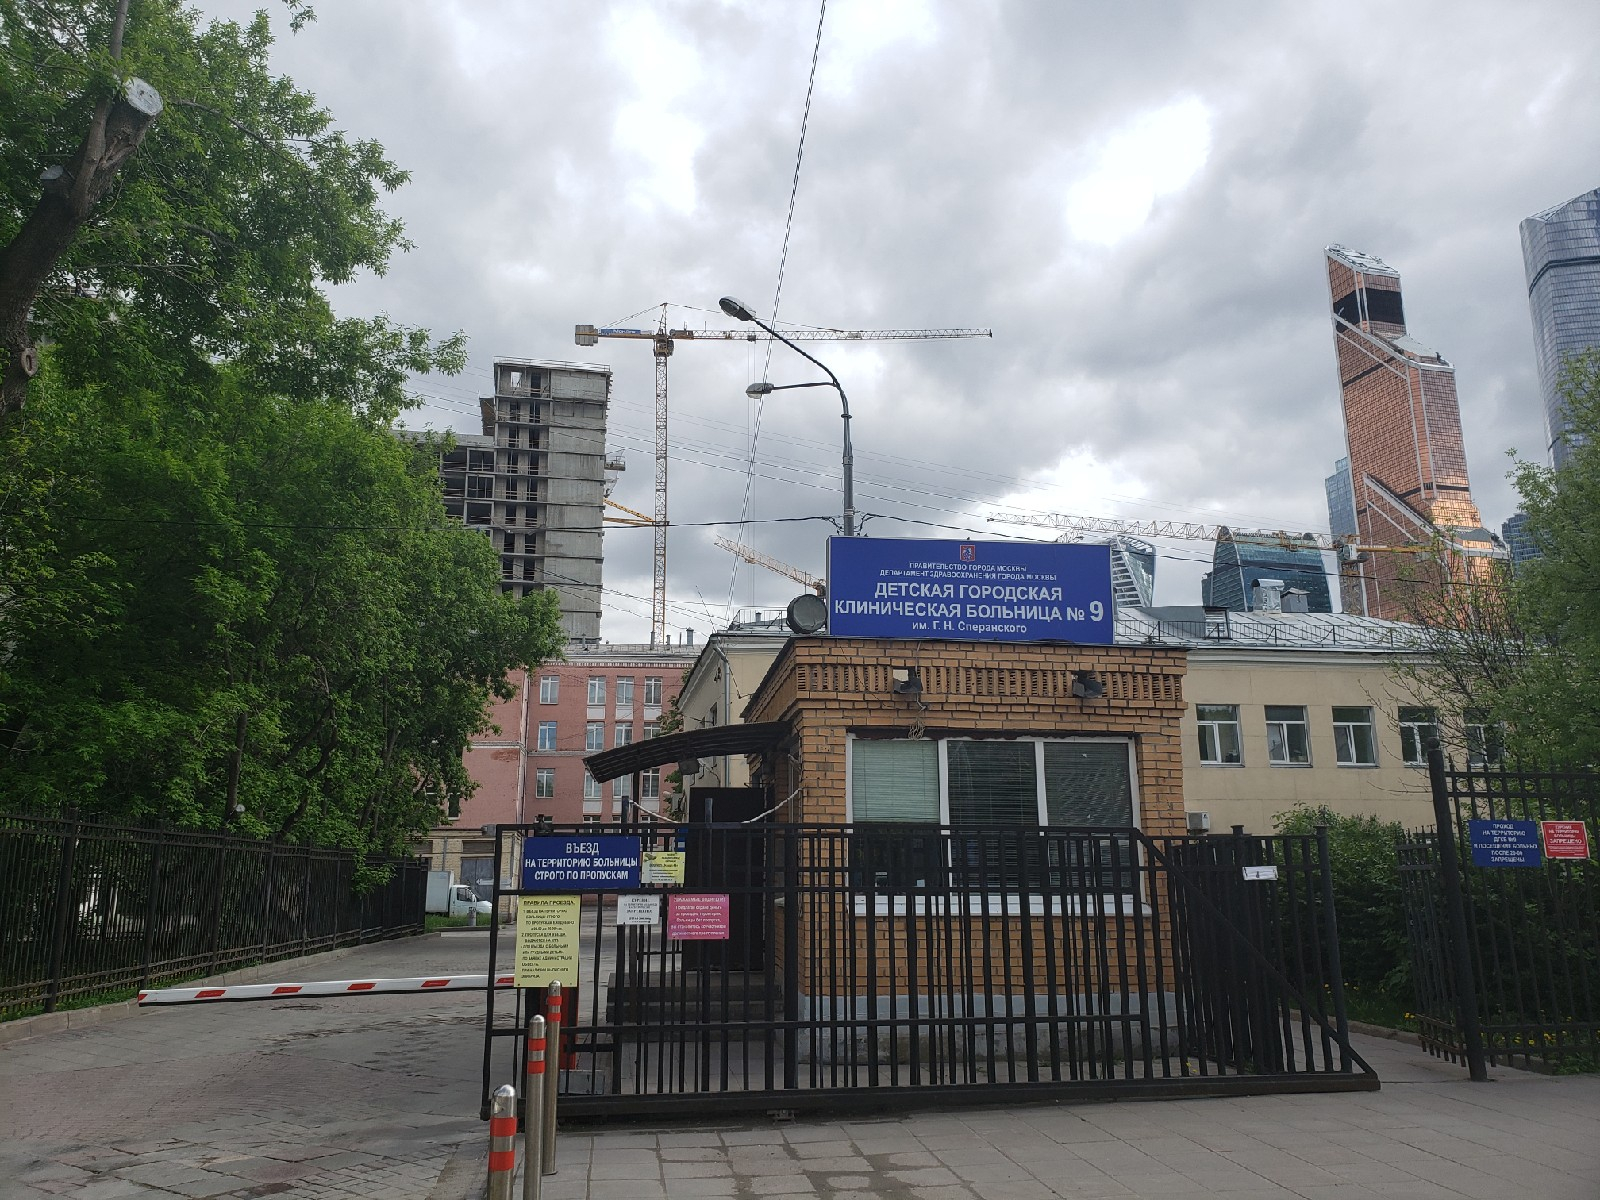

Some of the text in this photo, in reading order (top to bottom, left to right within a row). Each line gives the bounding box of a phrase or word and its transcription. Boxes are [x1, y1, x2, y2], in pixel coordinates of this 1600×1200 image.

[909, 562, 967, 571] ПРАВИТЕЛЬСТВО
[968, 564, 996, 572] ГОРОДА
[997, 572, 1025, 581] ГОРОДА
[874, 582, 1063, 602] ДЕТСКАЯ ГОРОДСКАЯ
[835, 599, 1104, 622] КЛИНИЧЕСКАЯ БОЛЬНИЦА № 9
[912, 620, 1027, 633] им. Г. Н. Сперанского
[565, 842, 600, 856] ВЪЕЗД
[524, 858, 536, 868] НА
[537, 858, 591, 868] ТЕРРИТОРИЮ
[593, 857, 638, 868] БОЛЬНИЦЫ
[534, 870, 629, 880] СТРОГО ПО ПРОПУСКАМ
